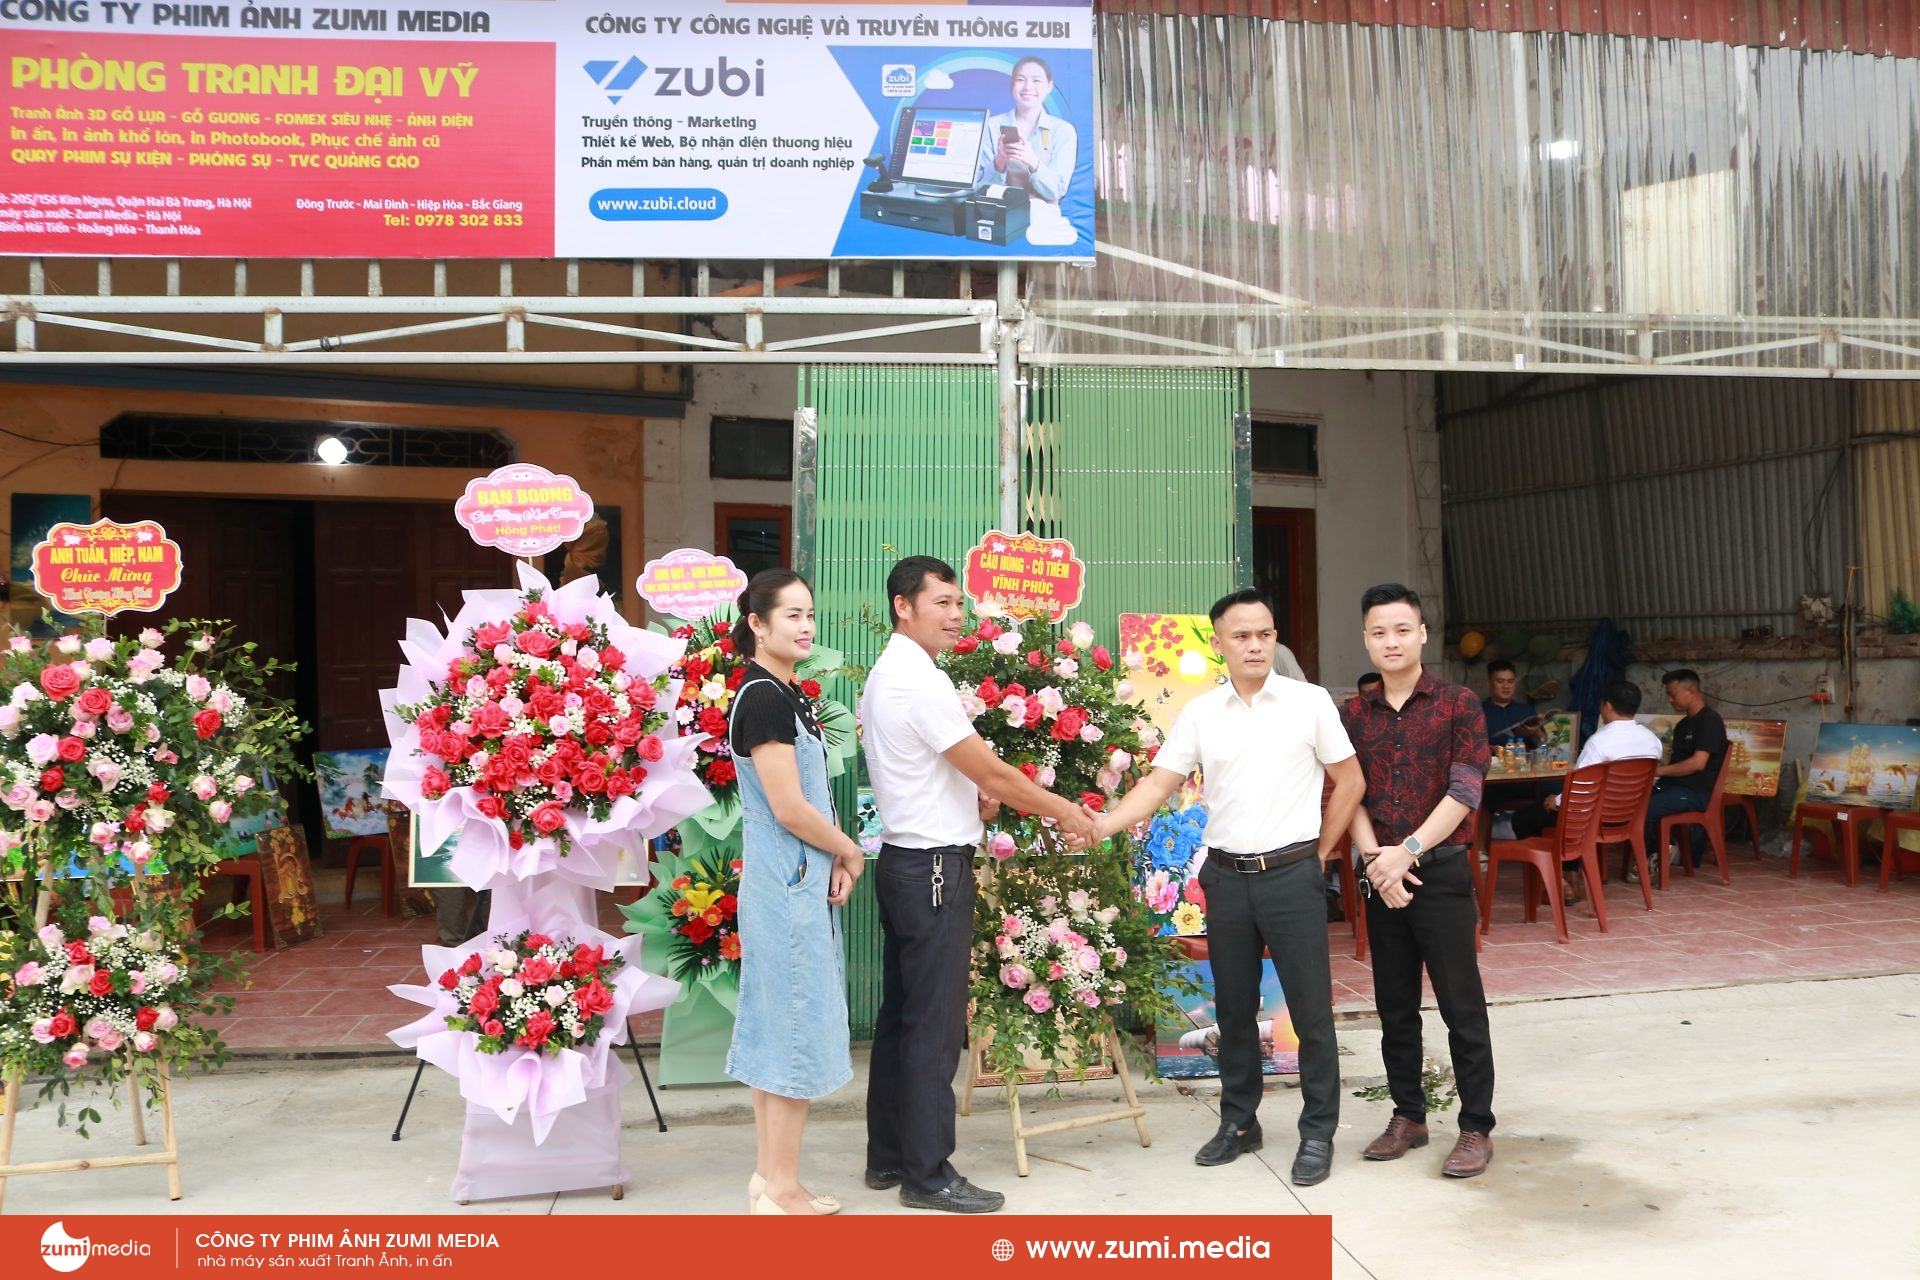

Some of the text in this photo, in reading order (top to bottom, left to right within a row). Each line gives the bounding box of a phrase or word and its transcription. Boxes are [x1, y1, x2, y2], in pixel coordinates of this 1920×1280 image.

[101, 1, 141, 25] TY
[152, 3, 229, 28] PHIM
[240, 0, 301, 29] ẢNH
[312, 8, 387, 31] ZUMI
[397, 10, 490, 33] MEDIA
[585, 12, 1071, 40] CÔNG TY CÔNG NGHỆ VÀ TRUYỀN THÔNG ZUBI
[11, 51, 480, 104] PHÒNG TRANH ĐẠI VỸ
[653, 55, 765, 98] zubi
[888, 73, 910, 82] zubi
[10, 106, 51, 120] Tranh
[55, 104, 84, 121] Ảnh
[87, 109, 107, 122] 3D
[111, 105, 135, 122] GỖ
[138, 110, 166, 125] LỤA
[180, 107, 204, 124] GỖ
[275, 113, 327, 126] FOMEX
[331, 111, 361, 126] SIÊU
[364, 115, 393, 129] NHẸ
[407, 111, 437, 127] ẢNH
[441, 113, 473, 130] ĐIỆN
[581, 114, 757, 130] Truyền thông Marketing
[83, 127, 114, 143] ảnh
[118, 127, 151, 145] khổ
[155, 130, 185, 146] lớn,
[210, 132, 305, 148] Photobook,
[311, 132, 350, 150] Phục
[354, 131, 383, 147] chế
[388, 132, 417, 148] ảnh
[422, 134, 441, 148] cũ
[581, 134, 853, 151] Thiết kế Web, Bộ nhận diện thương hiệu
[11, 149, 57, 164] QUAY
[63, 150, 106, 164] PHIM
[136, 149, 173, 168] KIỆN
[289, 154, 321, 169] TVC
[324, 151, 382, 169] QUẢNG
[386, 153, 421, 169] CÁO
[581, 155, 855, 171] Phần mềm bán hàng, quản trị doanh nghiệp
[60, 194, 82, 205] Kim
[117, 195, 145, 208] Quận
[146, 196, 165, 207] Hai
[166, 196, 181, 207] Bà
[217, 197, 232, 208] Hà
[233, 197, 252, 210] Nội
[296, 198, 324, 211] Đông
[363, 199, 383, 210] Mai
[384, 199, 408, 210] Đình
[417, 199, 440, 212] Hiệp
[443, 199, 463, 210] Hòa
[472, 198, 491, 210] Bắc
[493, 199, 522, 212] Giang
[597, 197, 717, 211] www.zubi.cloud
[75, 209, 103, 220] Zumi
[104, 210, 138, 221] Media
[146, 211, 161, 221] Hà
[163, 211, 181, 222] Nội
[383, 214, 523, 227] Tel: 0978 302 833
[115, 223, 137, 234] Hóa
[145, 224, 178, 235] Thanh
[179, 225, 201, 235] Hóa
[477, 486, 573, 508] BẠN BOONG
[495, 524, 561, 536] Hồng Phát!
[50, 547, 74, 565] ANH
[109, 543, 136, 568] HIỆP,
[138, 546, 164, 563] NAM
[980, 550, 999, 573] CẬU
[1000, 553, 1025, 573] HÙNG
[1031, 557, 1045, 576] CÔ
[60, 566, 153, 585] Chúc Mừng
[992, 574, 1054, 595] VĨNH PHÚC
